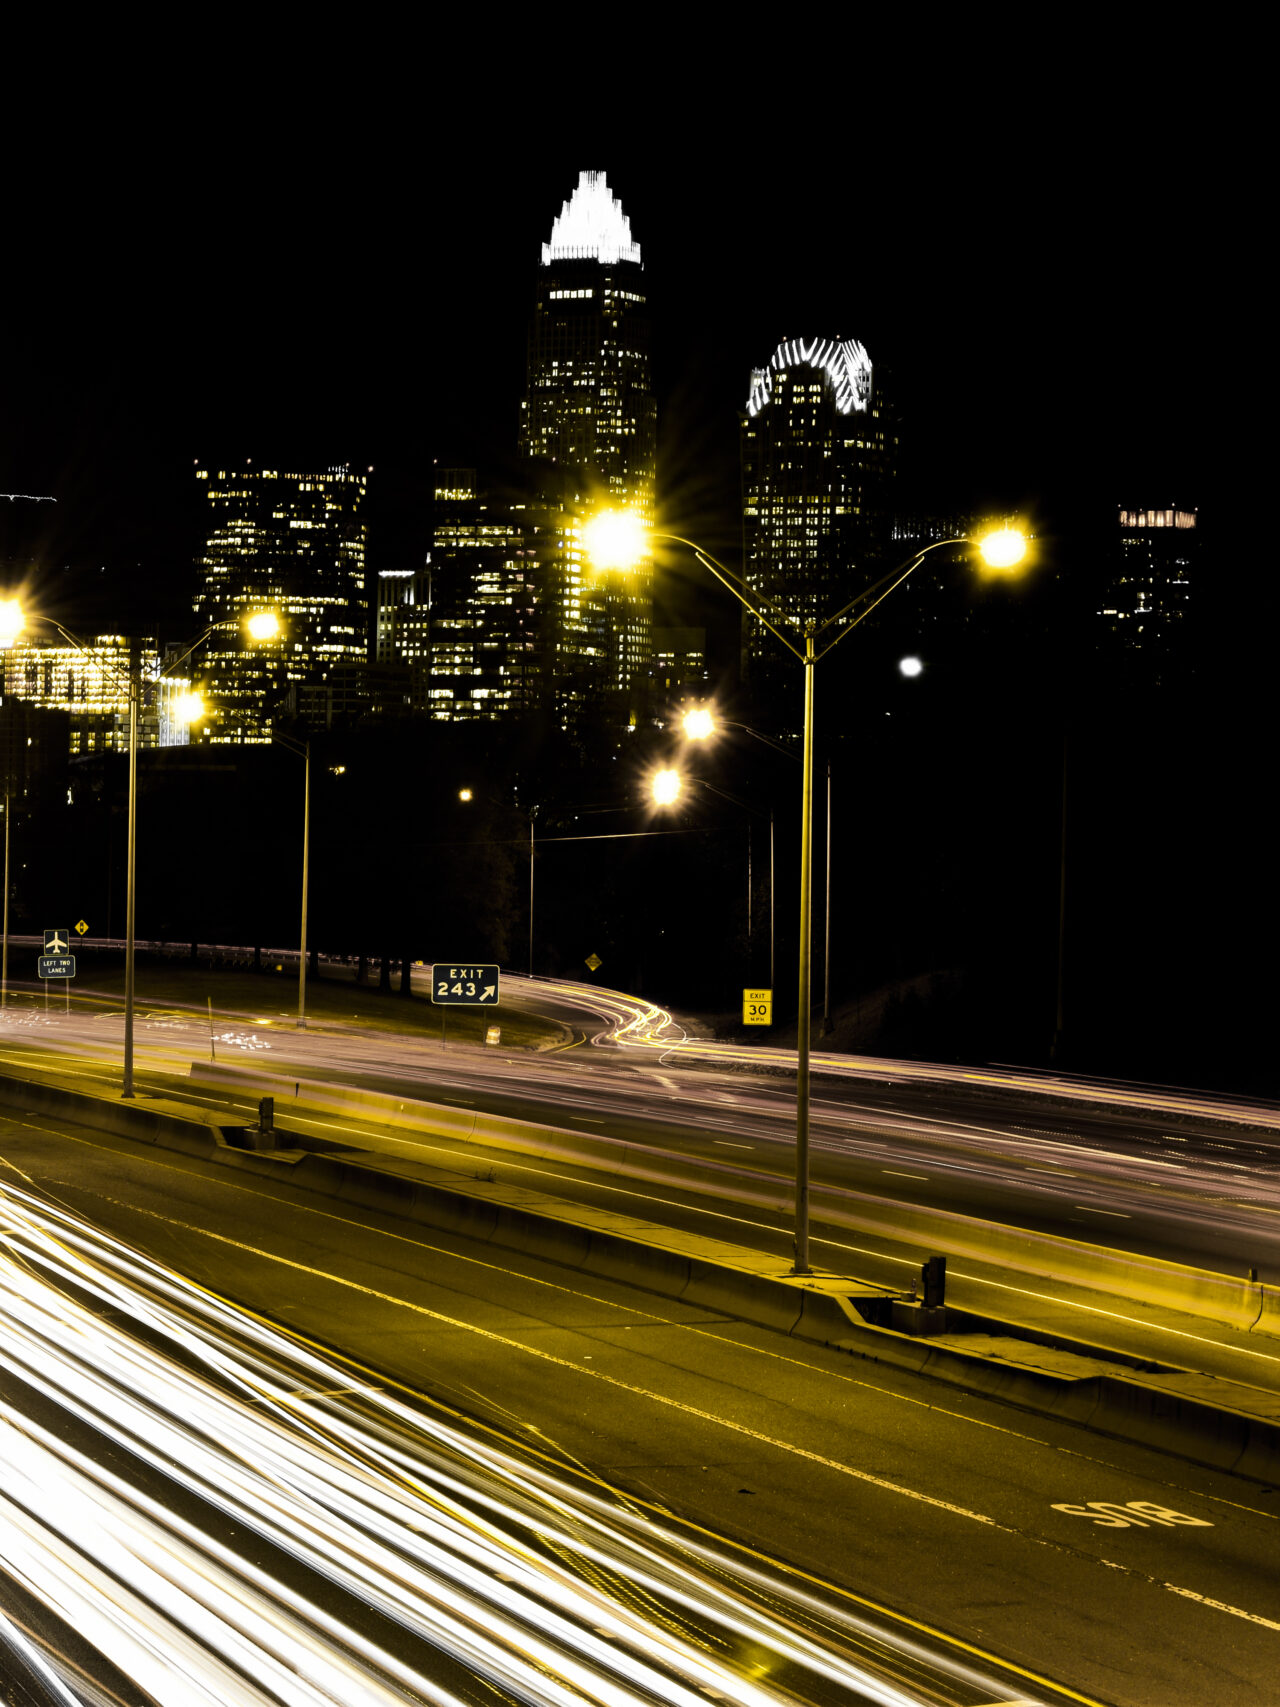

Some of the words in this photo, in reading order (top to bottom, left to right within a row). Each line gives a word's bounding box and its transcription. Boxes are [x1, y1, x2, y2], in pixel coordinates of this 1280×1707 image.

[450, 968, 484, 979] EXIT
[437, 981, 476, 996] 243
[749, 1004, 767, 1015] 30
[1050, 1501, 1215, 1528] BUS
